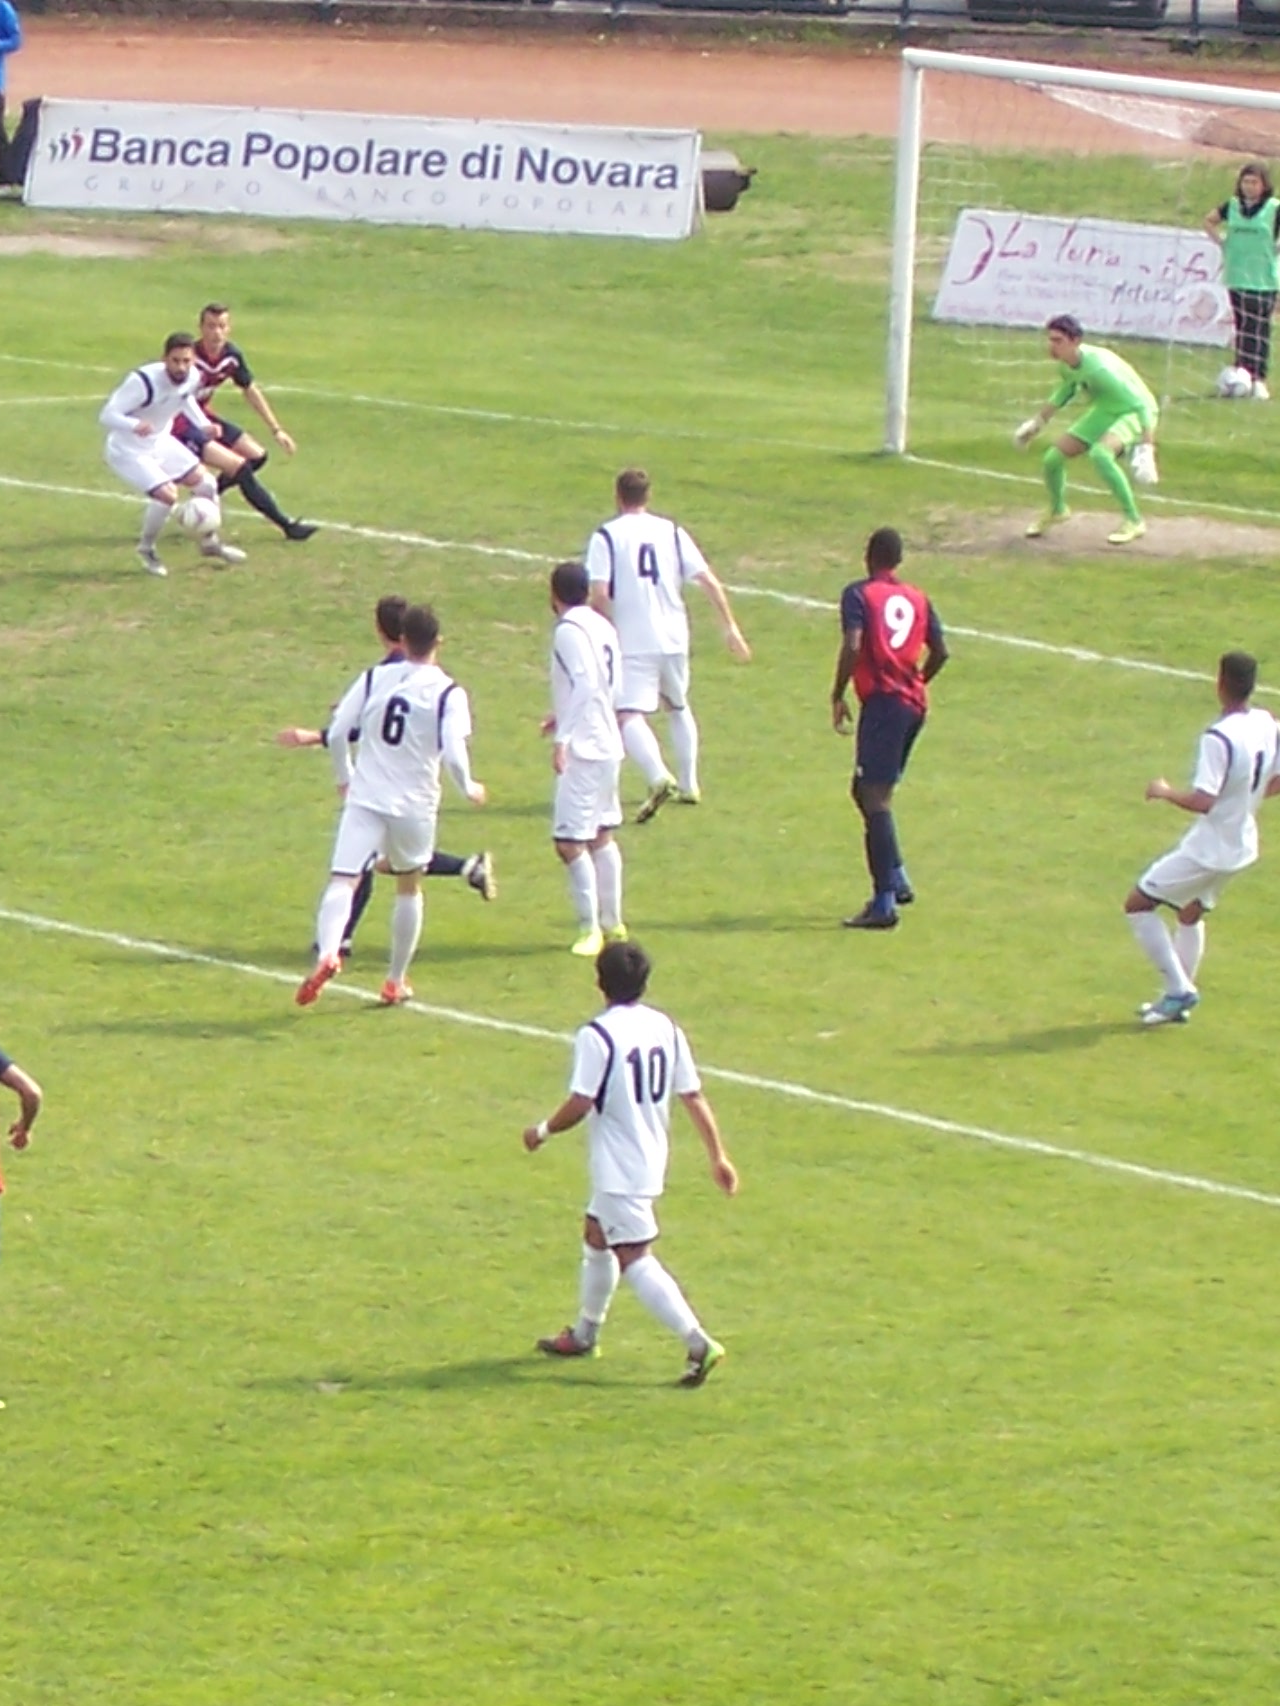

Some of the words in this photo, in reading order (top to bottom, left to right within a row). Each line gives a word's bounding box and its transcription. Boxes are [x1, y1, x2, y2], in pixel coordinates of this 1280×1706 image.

[89, 128, 230, 168] Banca
[242, 132, 448, 180] Popolare
[460, 144, 504, 180] di
[515, 147, 680, 190] Novara
[84, 174, 262, 197] GRUPPO
[318, 184, 448, 207] BANCO
[477, 194, 676, 219] POPOLARE
[638, 542, 659, 586] 4
[884, 593, 916, 650] 9
[602, 643, 614, 687] 3
[382, 696, 411, 747] 6
[625, 1046, 667, 1105] 10
